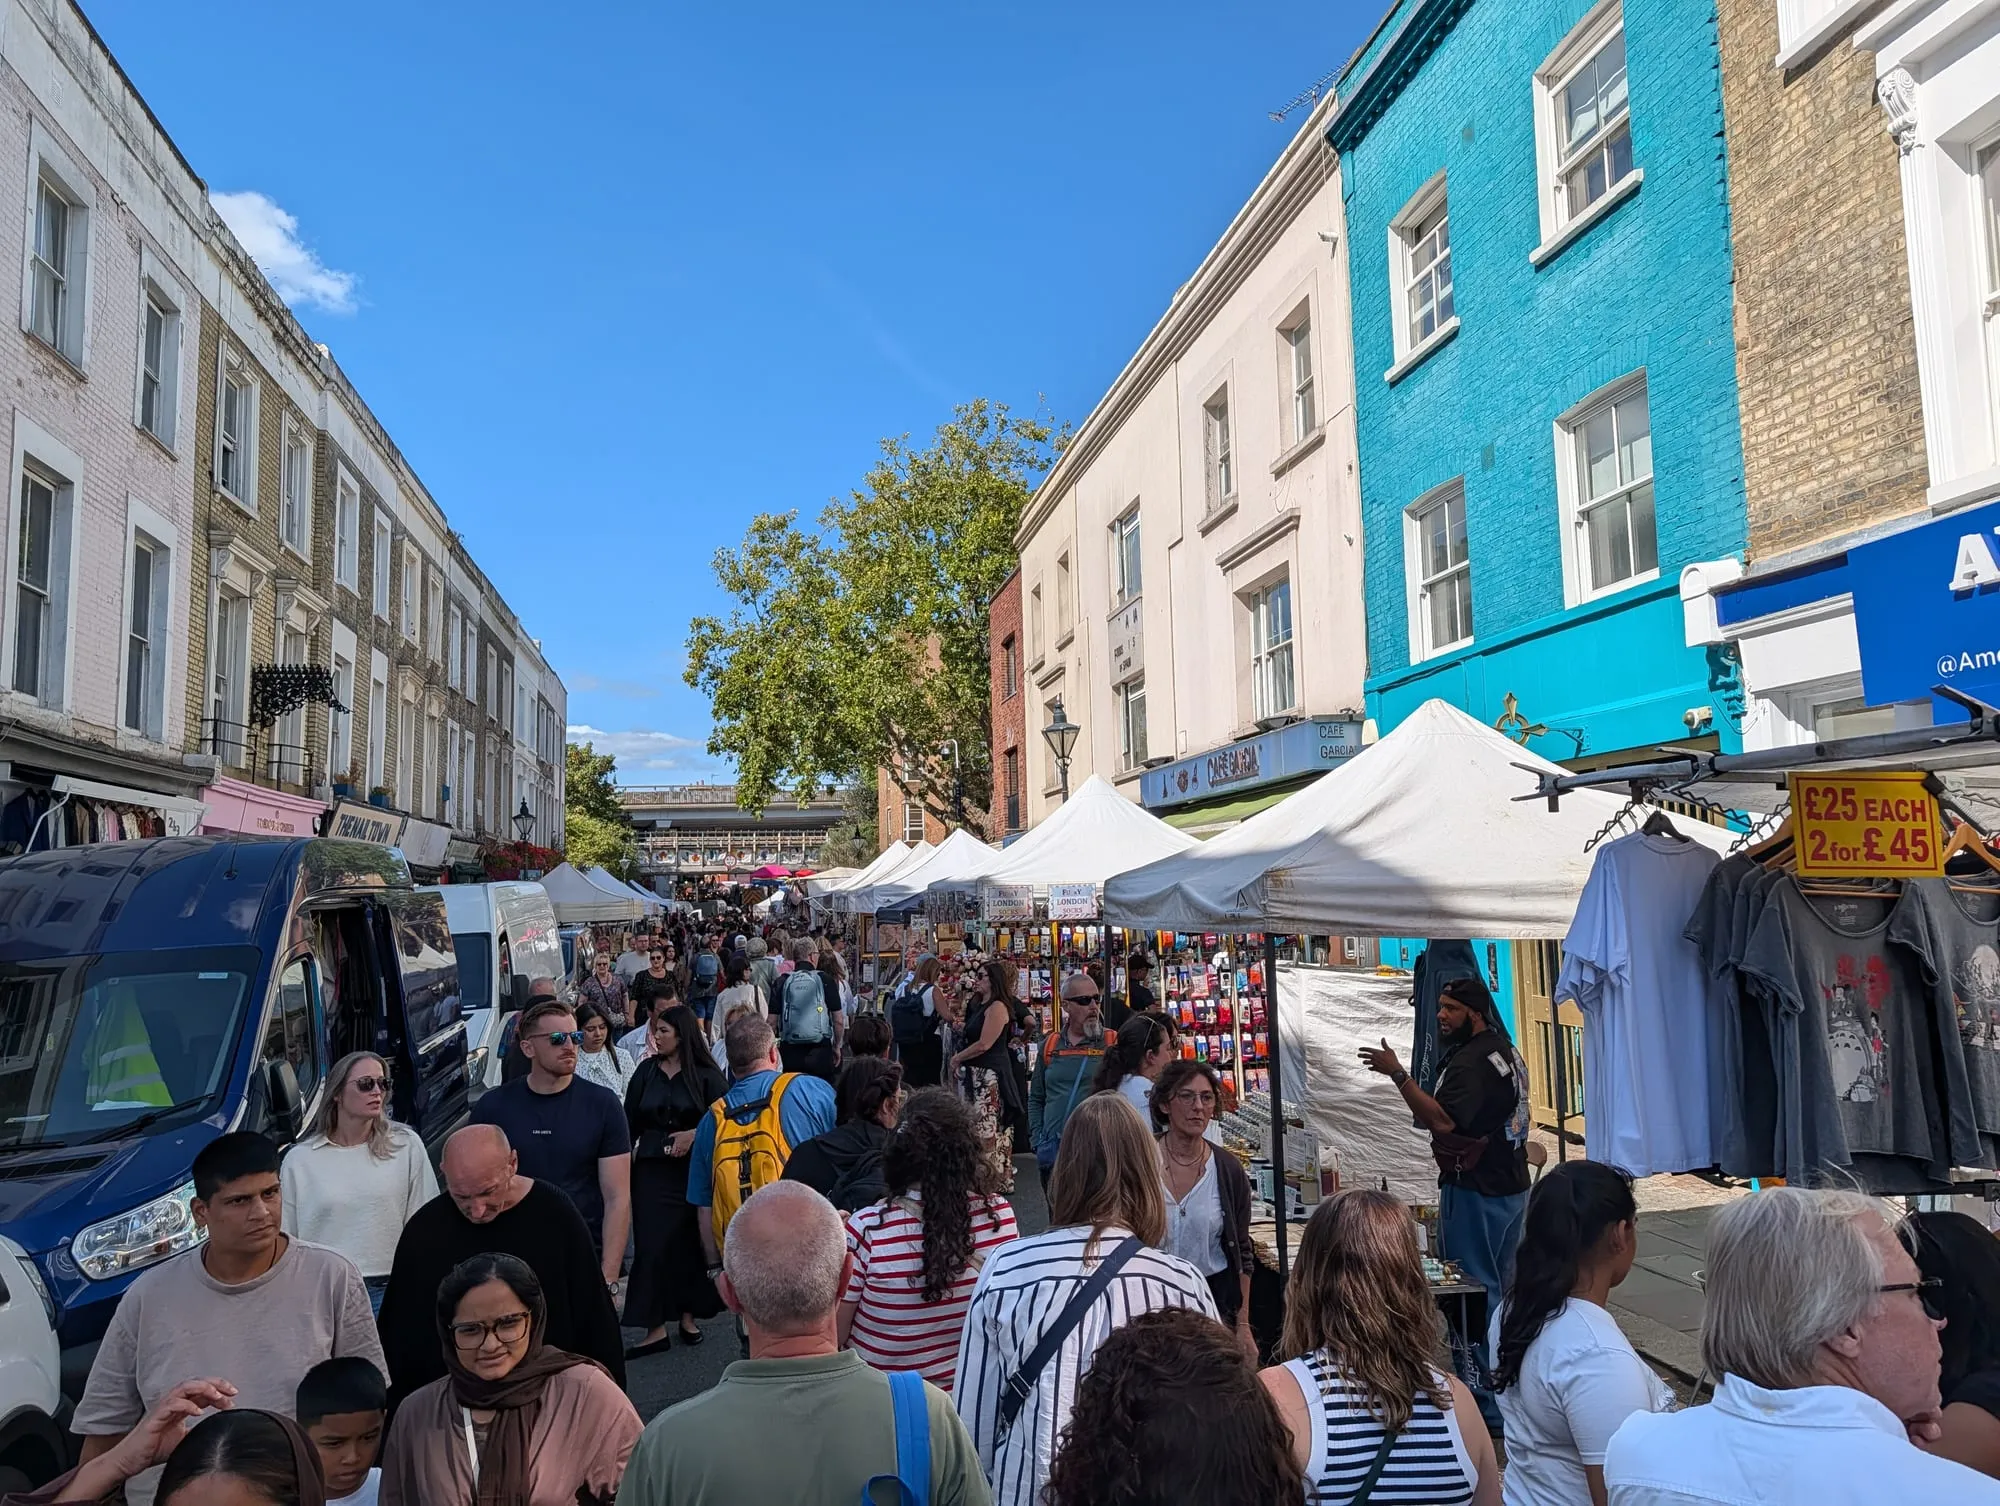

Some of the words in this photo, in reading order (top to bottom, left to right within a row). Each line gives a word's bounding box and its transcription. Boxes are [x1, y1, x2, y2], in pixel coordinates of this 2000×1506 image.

[1949, 533, 2000, 591] A
[1320, 745, 1355, 759] GARCIA
[1805, 787, 1858, 821] £25
[1863, 799, 1927, 822] EACH
[368, 820, 392, 844] TOWN
[1809, 829, 1829, 861] 2
[1830, 842, 1860, 861] for
[993, 899, 1024, 907] LONDON
[1056, 897, 1088, 906] LONDON
